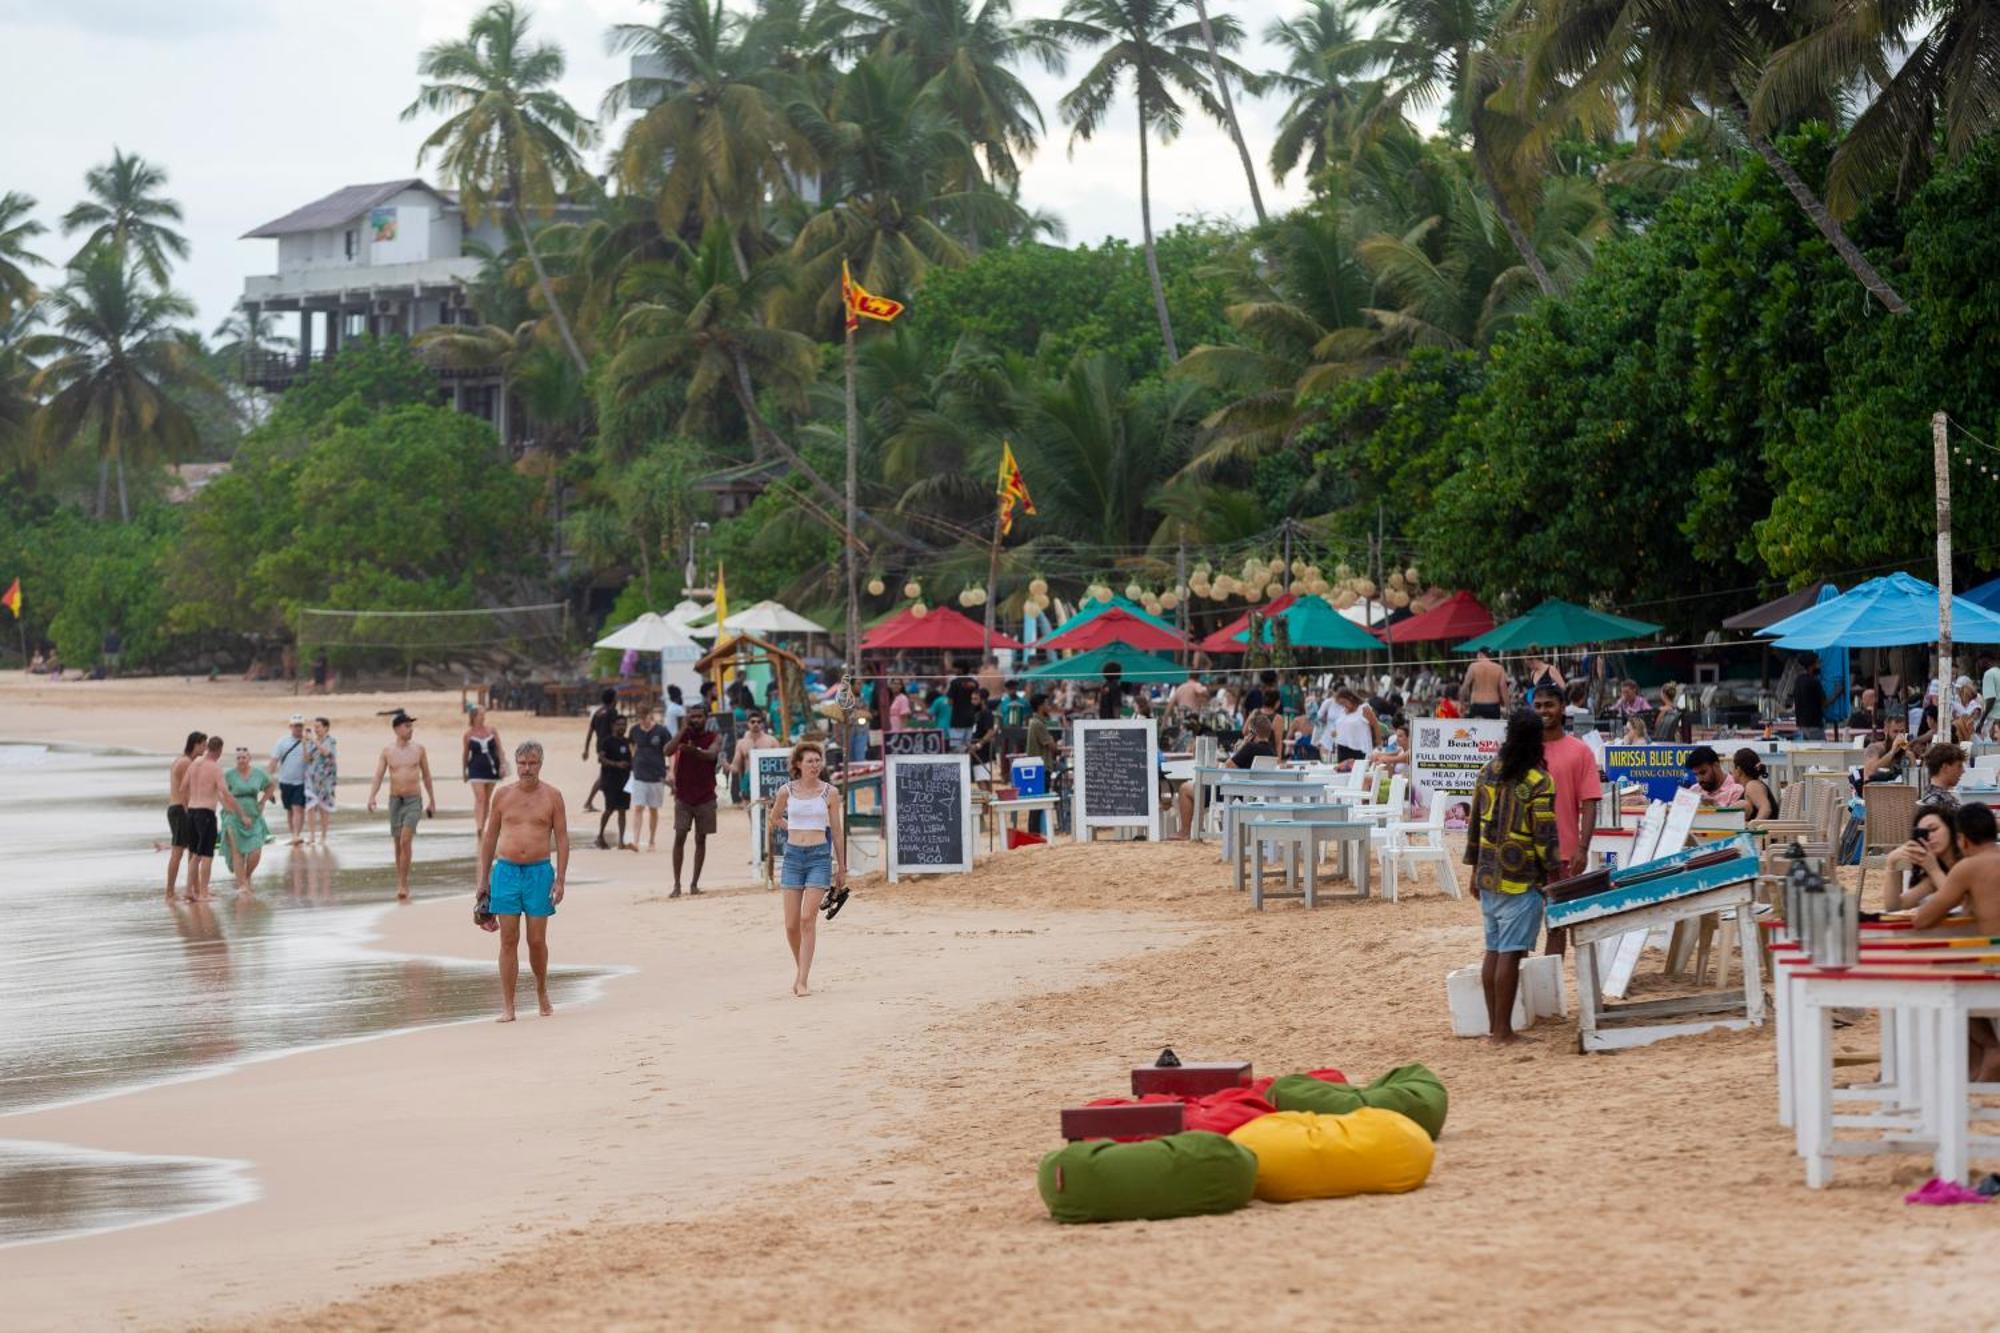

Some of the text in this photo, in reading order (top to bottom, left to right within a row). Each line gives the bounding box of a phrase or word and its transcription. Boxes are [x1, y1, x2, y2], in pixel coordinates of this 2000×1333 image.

[1416, 753, 1436, 761] FULL
[1463, 754, 1494, 762] MASSA
[1609, 750, 1646, 767] MIRISSA
[1649, 750, 1673, 767] BLUE
[1630, 769, 1685, 778] DIVING CENTER
[1420, 779, 1443, 787] NECK
[908, 791, 934, 803] 700
[917, 852, 942, 864] 800
